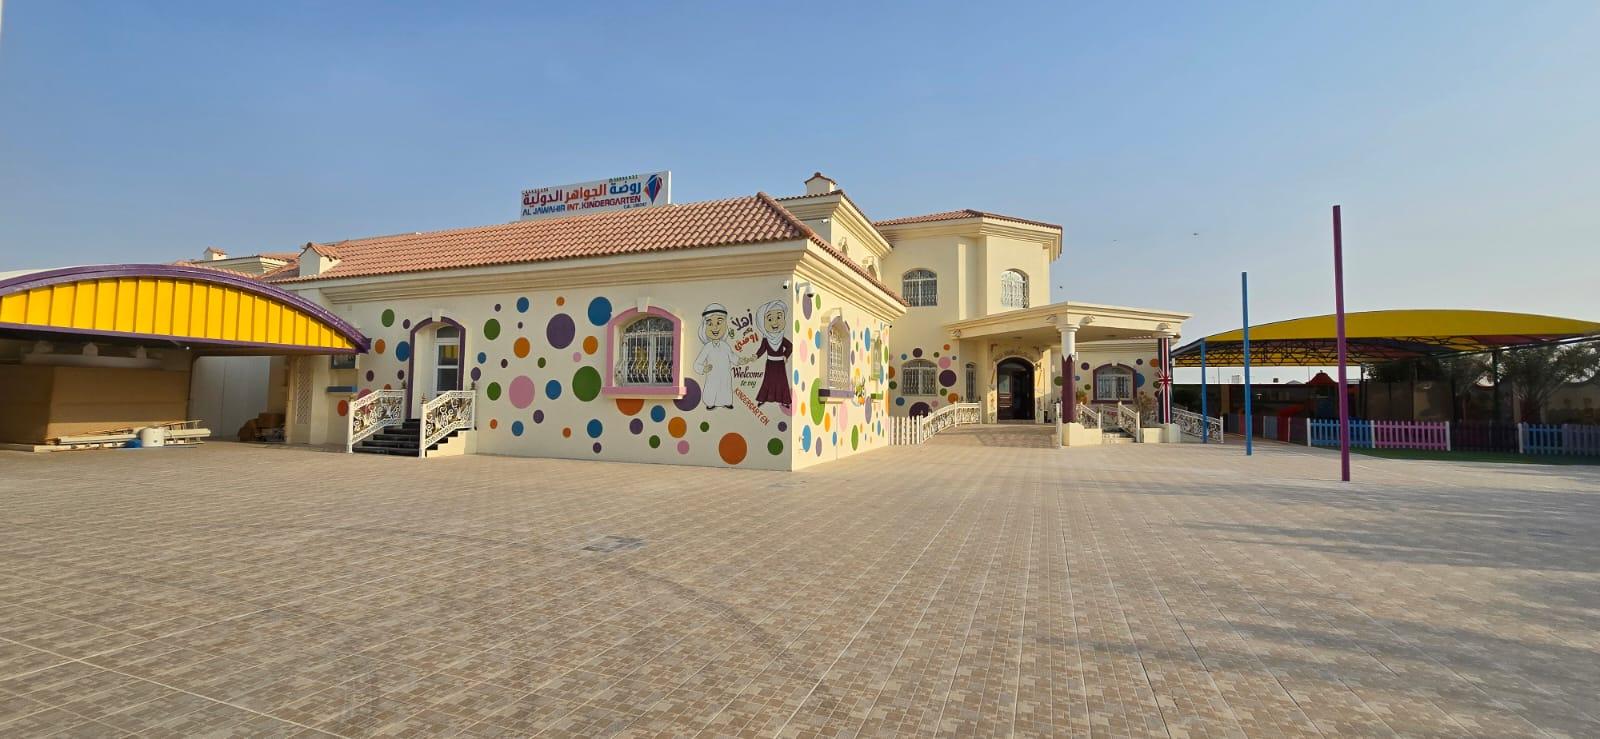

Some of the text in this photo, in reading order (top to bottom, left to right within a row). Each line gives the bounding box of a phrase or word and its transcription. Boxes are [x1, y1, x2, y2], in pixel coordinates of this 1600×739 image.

[522, 208, 532, 216] AL
[533, 205, 565, 214] JAWAHIR
[581, 195, 641, 209] KINDERGARTEN
[523, 181, 641, 207] روضة الجواهر الدولية
[731, 366, 764, 378] Welcome
[735, 387, 769, 426] KINDERGARTEN
